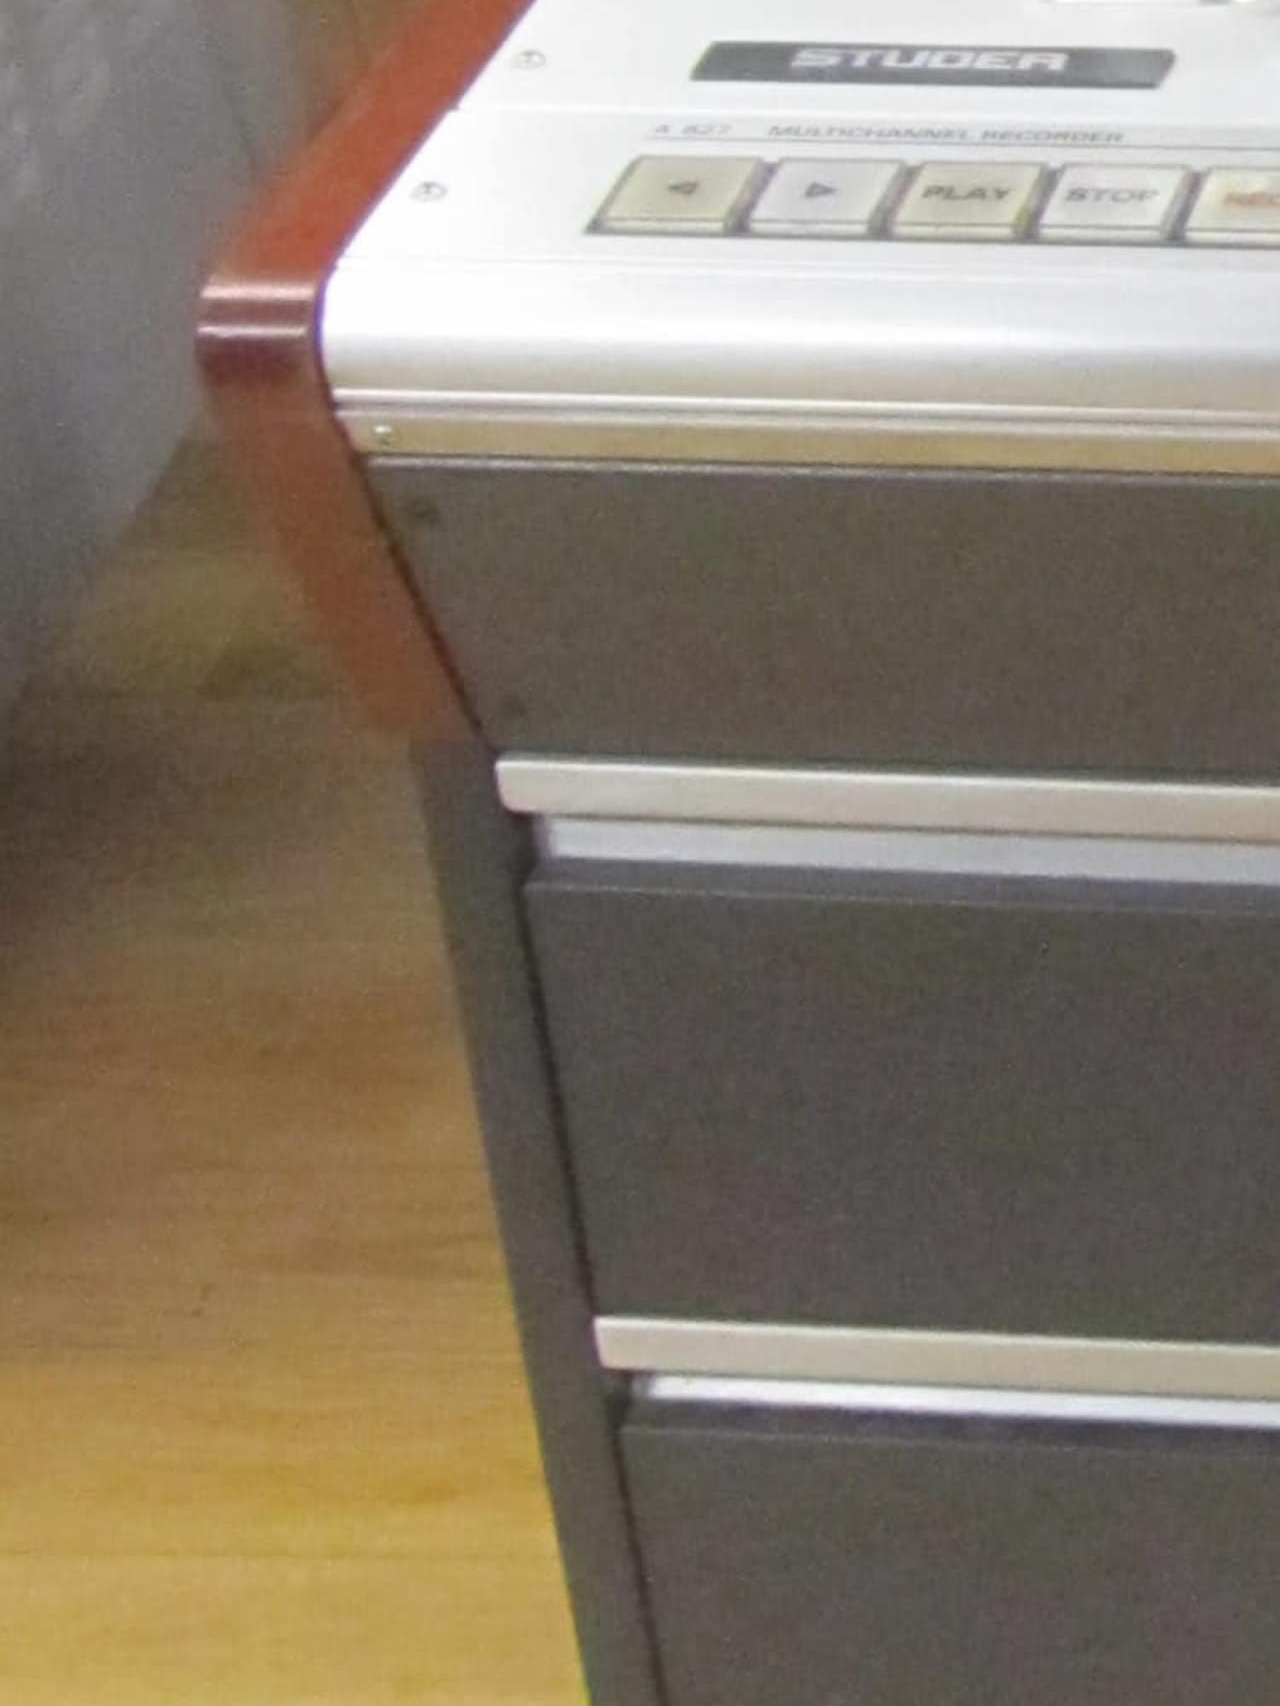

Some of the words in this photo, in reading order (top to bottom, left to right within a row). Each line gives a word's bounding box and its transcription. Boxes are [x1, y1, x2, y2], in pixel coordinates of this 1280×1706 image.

[790, 46, 1071, 71] STUDER
[980, 128, 1125, 143] RECORDER
[920, 187, 1011, 202] PLAY
[1064, 187, 1159, 203] STOP
